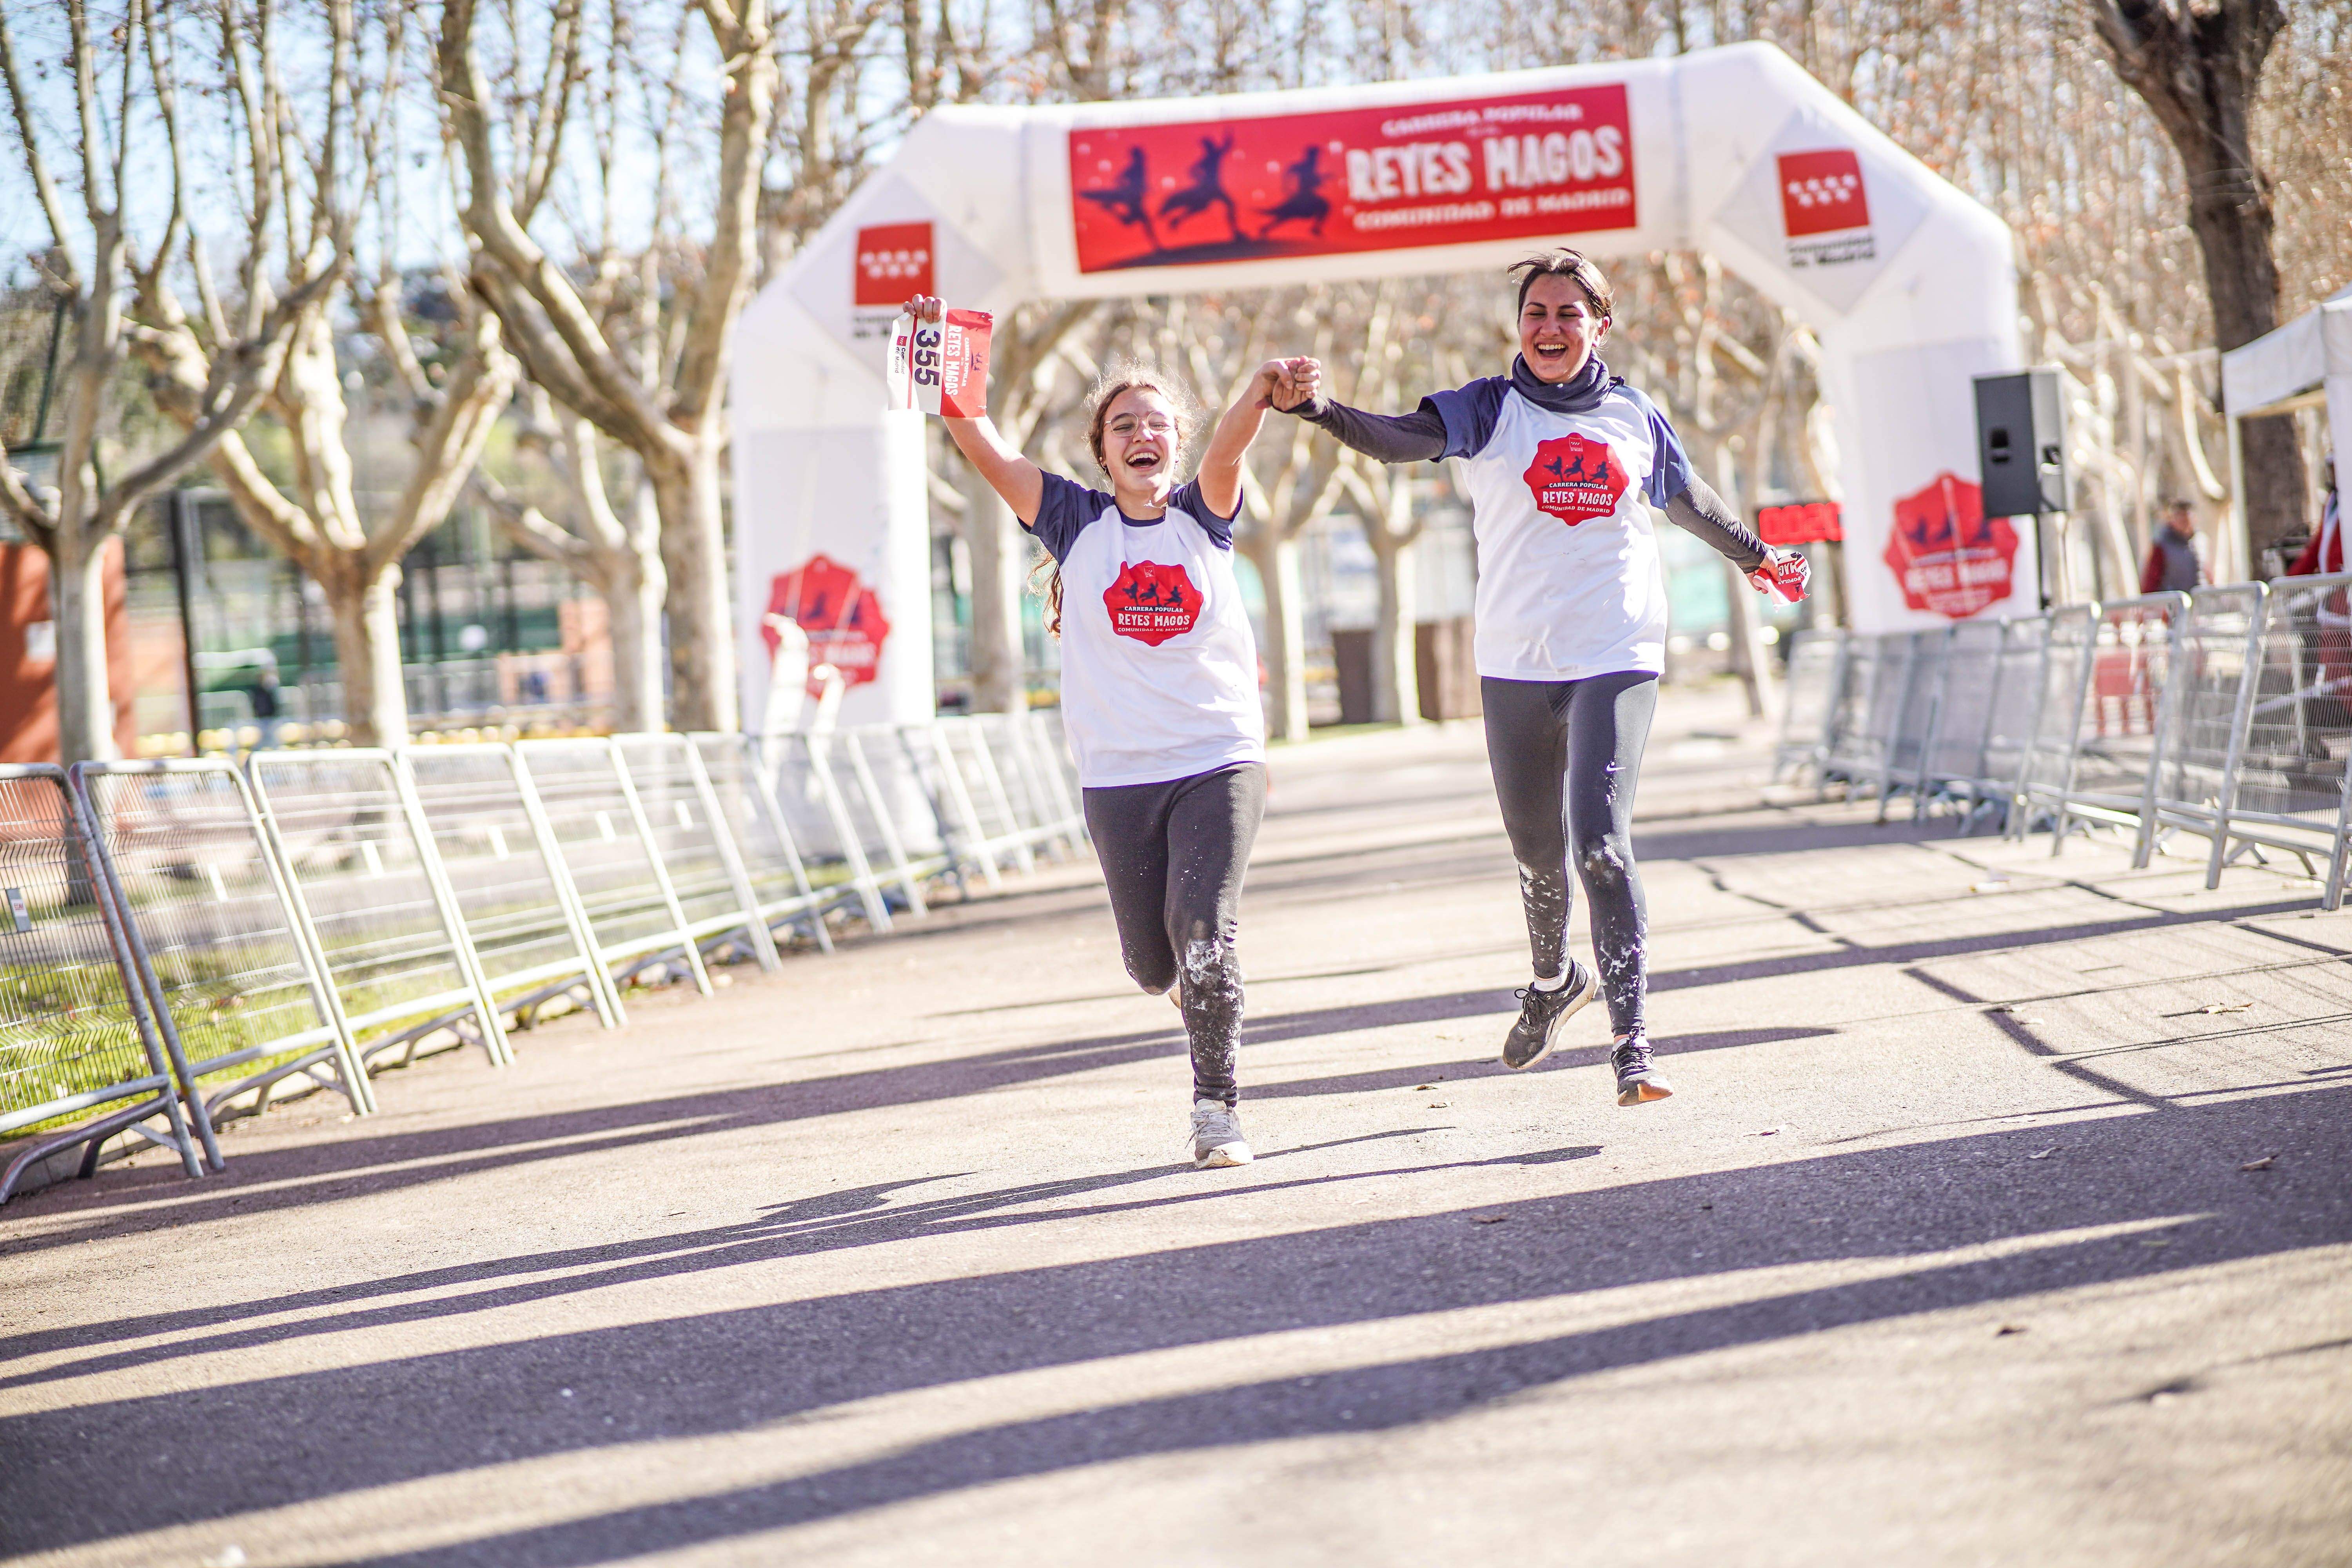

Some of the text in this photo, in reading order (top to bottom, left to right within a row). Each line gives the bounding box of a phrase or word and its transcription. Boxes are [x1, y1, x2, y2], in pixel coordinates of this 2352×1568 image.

[1345, 124, 1624, 203] REYES MAGOS
[1353, 187, 1632, 229] COMUNIDAD DE MADRID
[915, 329, 941, 385] 355
[945, 325, 962, 396] REYES MAGOS
[1543, 491, 1613, 506] REYES MAGOS
[1118, 613, 1191, 627] REYES MAGOS
